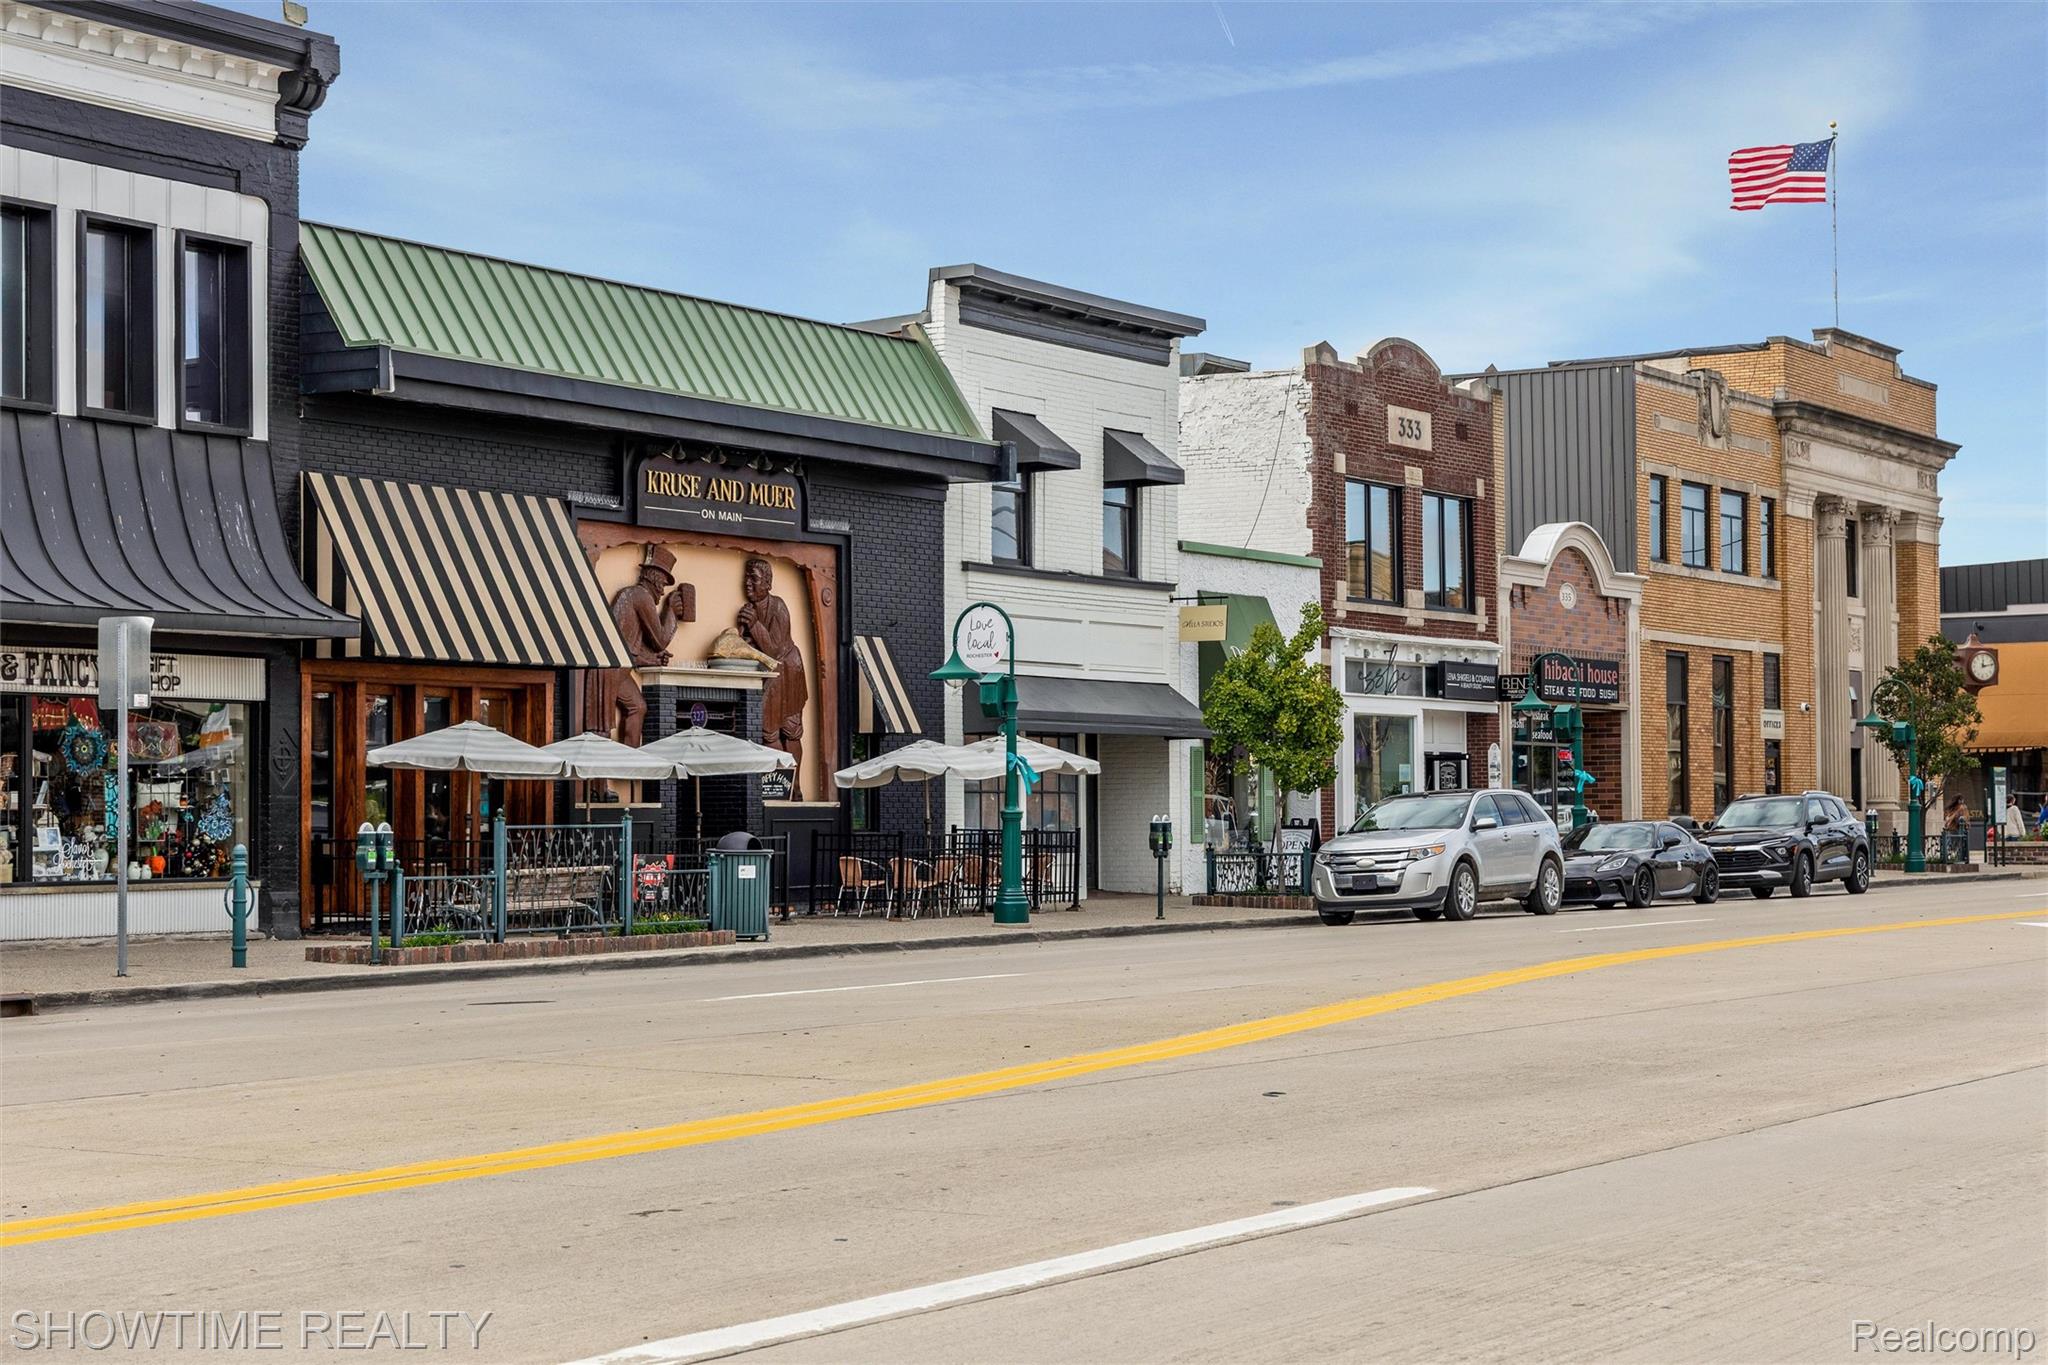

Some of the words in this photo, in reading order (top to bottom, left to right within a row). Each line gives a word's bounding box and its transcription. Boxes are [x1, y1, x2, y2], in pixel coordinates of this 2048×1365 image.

[1398, 416, 1422, 441] 333
[647, 470, 702, 499] KRUSE
[705, 478, 744, 503] AND
[749, 482, 796, 510] MUER
[701, 508, 716, 519] ON
[718, 511, 742, 522] MAIN
[970, 614, 994, 631] Love
[967, 630, 997, 650] local
[1544, 660, 1584, 682] hibaci
[1587, 663, 1618, 685] house
[151, 675, 181, 692] HOP
[1544, 685, 1564, 696] STEAK
[1567, 687, 1597, 698] SEFOOD
[1599, 689, 1618, 700] SUSHI
[1763, 720, 1782, 729] OFFICES
[1532, 729, 1553, 740] seafood
